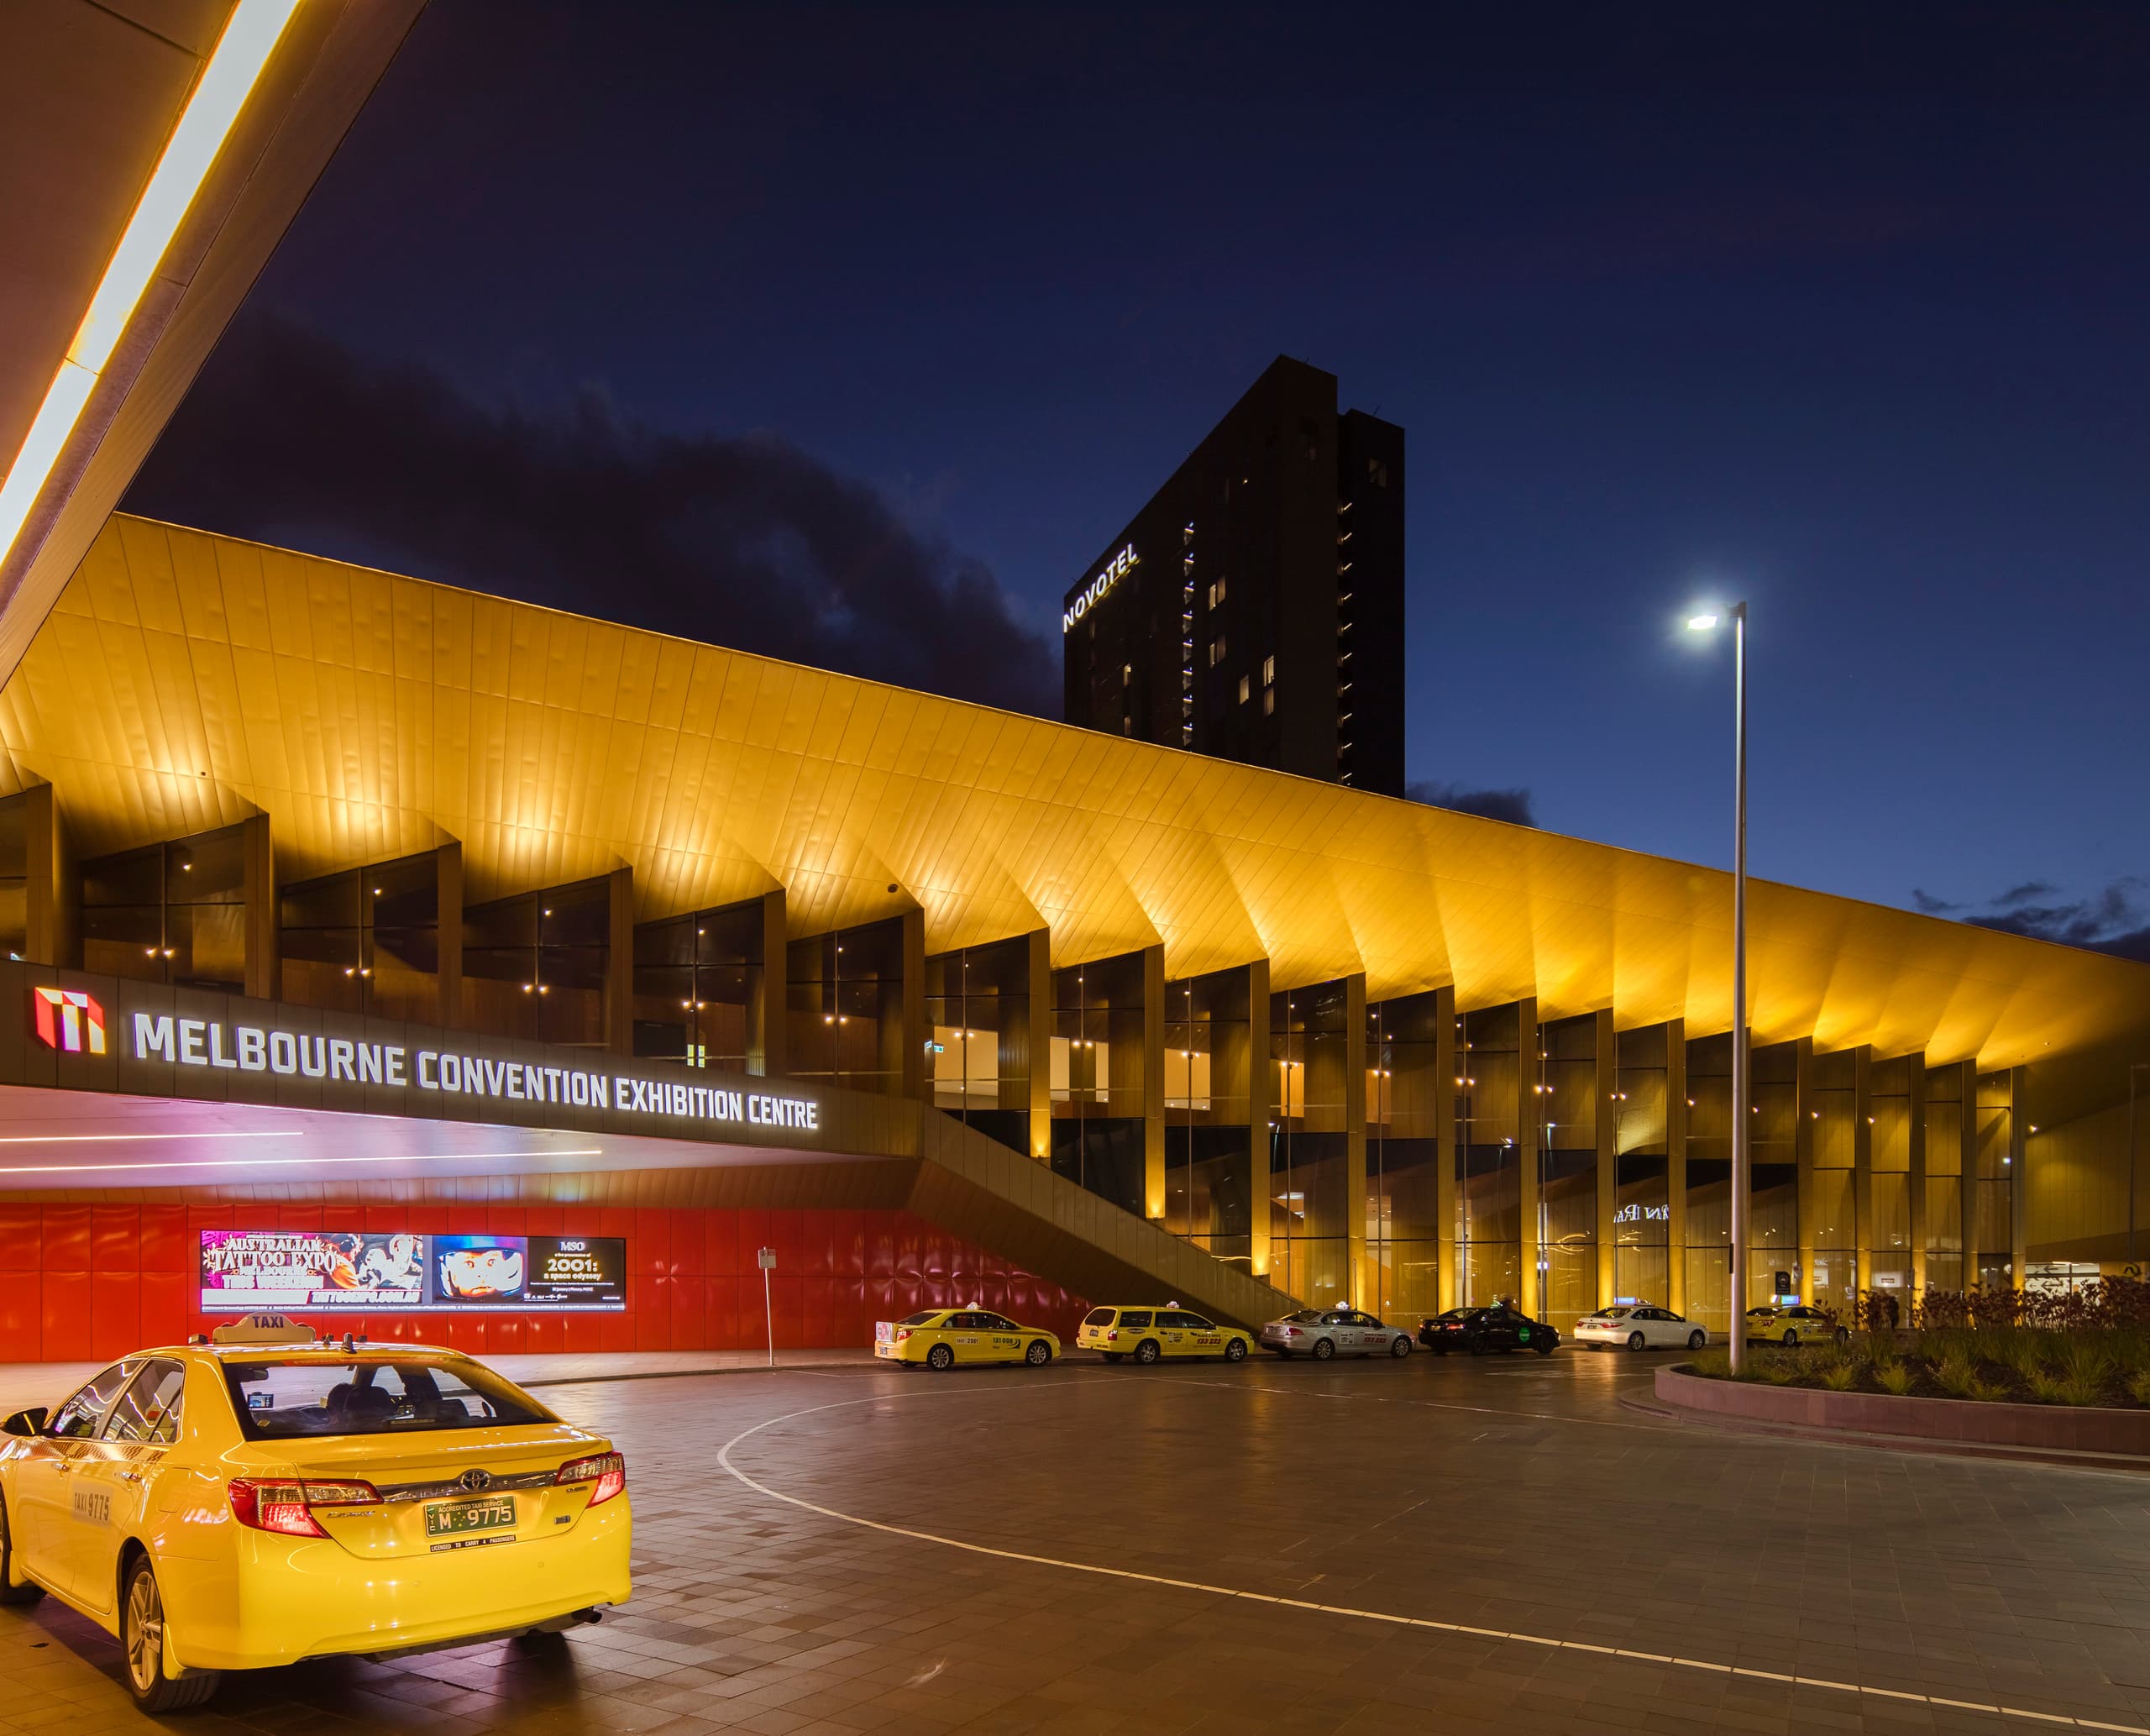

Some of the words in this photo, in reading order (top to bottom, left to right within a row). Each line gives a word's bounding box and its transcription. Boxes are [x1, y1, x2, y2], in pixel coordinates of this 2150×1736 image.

[1063, 543, 1137, 633] NOVOTEL
[134, 1012, 407, 1086] MELBOURNE
[417, 1051, 607, 1108] CONVENTION
[615, 1078, 742, 1121] EXHIBITION
[748, 1094, 818, 1130] CENTRE
[227, 1238, 321, 1251] AUSTRALIAN
[560, 1241, 585, 1251] MSO
[212, 1250, 286, 1272] TATTOO
[291, 1251, 336, 1272] EXPO
[548, 1258, 598, 1272] 2001:
[550, 1272, 571, 1281] space
[572, 1272, 601, 1281] odyssey
[252, 1316, 284, 1329] TAXI
[74, 1492, 87, 1513] TAXI
[88, 1493, 109, 1521] 9775
[438, 1503, 471, 1513] ACCREDITED
[483, 1499, 504, 1508] SERVICE
[438, 1513, 452, 1530] M
[467, 1505, 512, 1527] 9775
[431, 1544, 452, 1552] LICENSED
[490, 1535, 515, 1544] PASSENGERS
